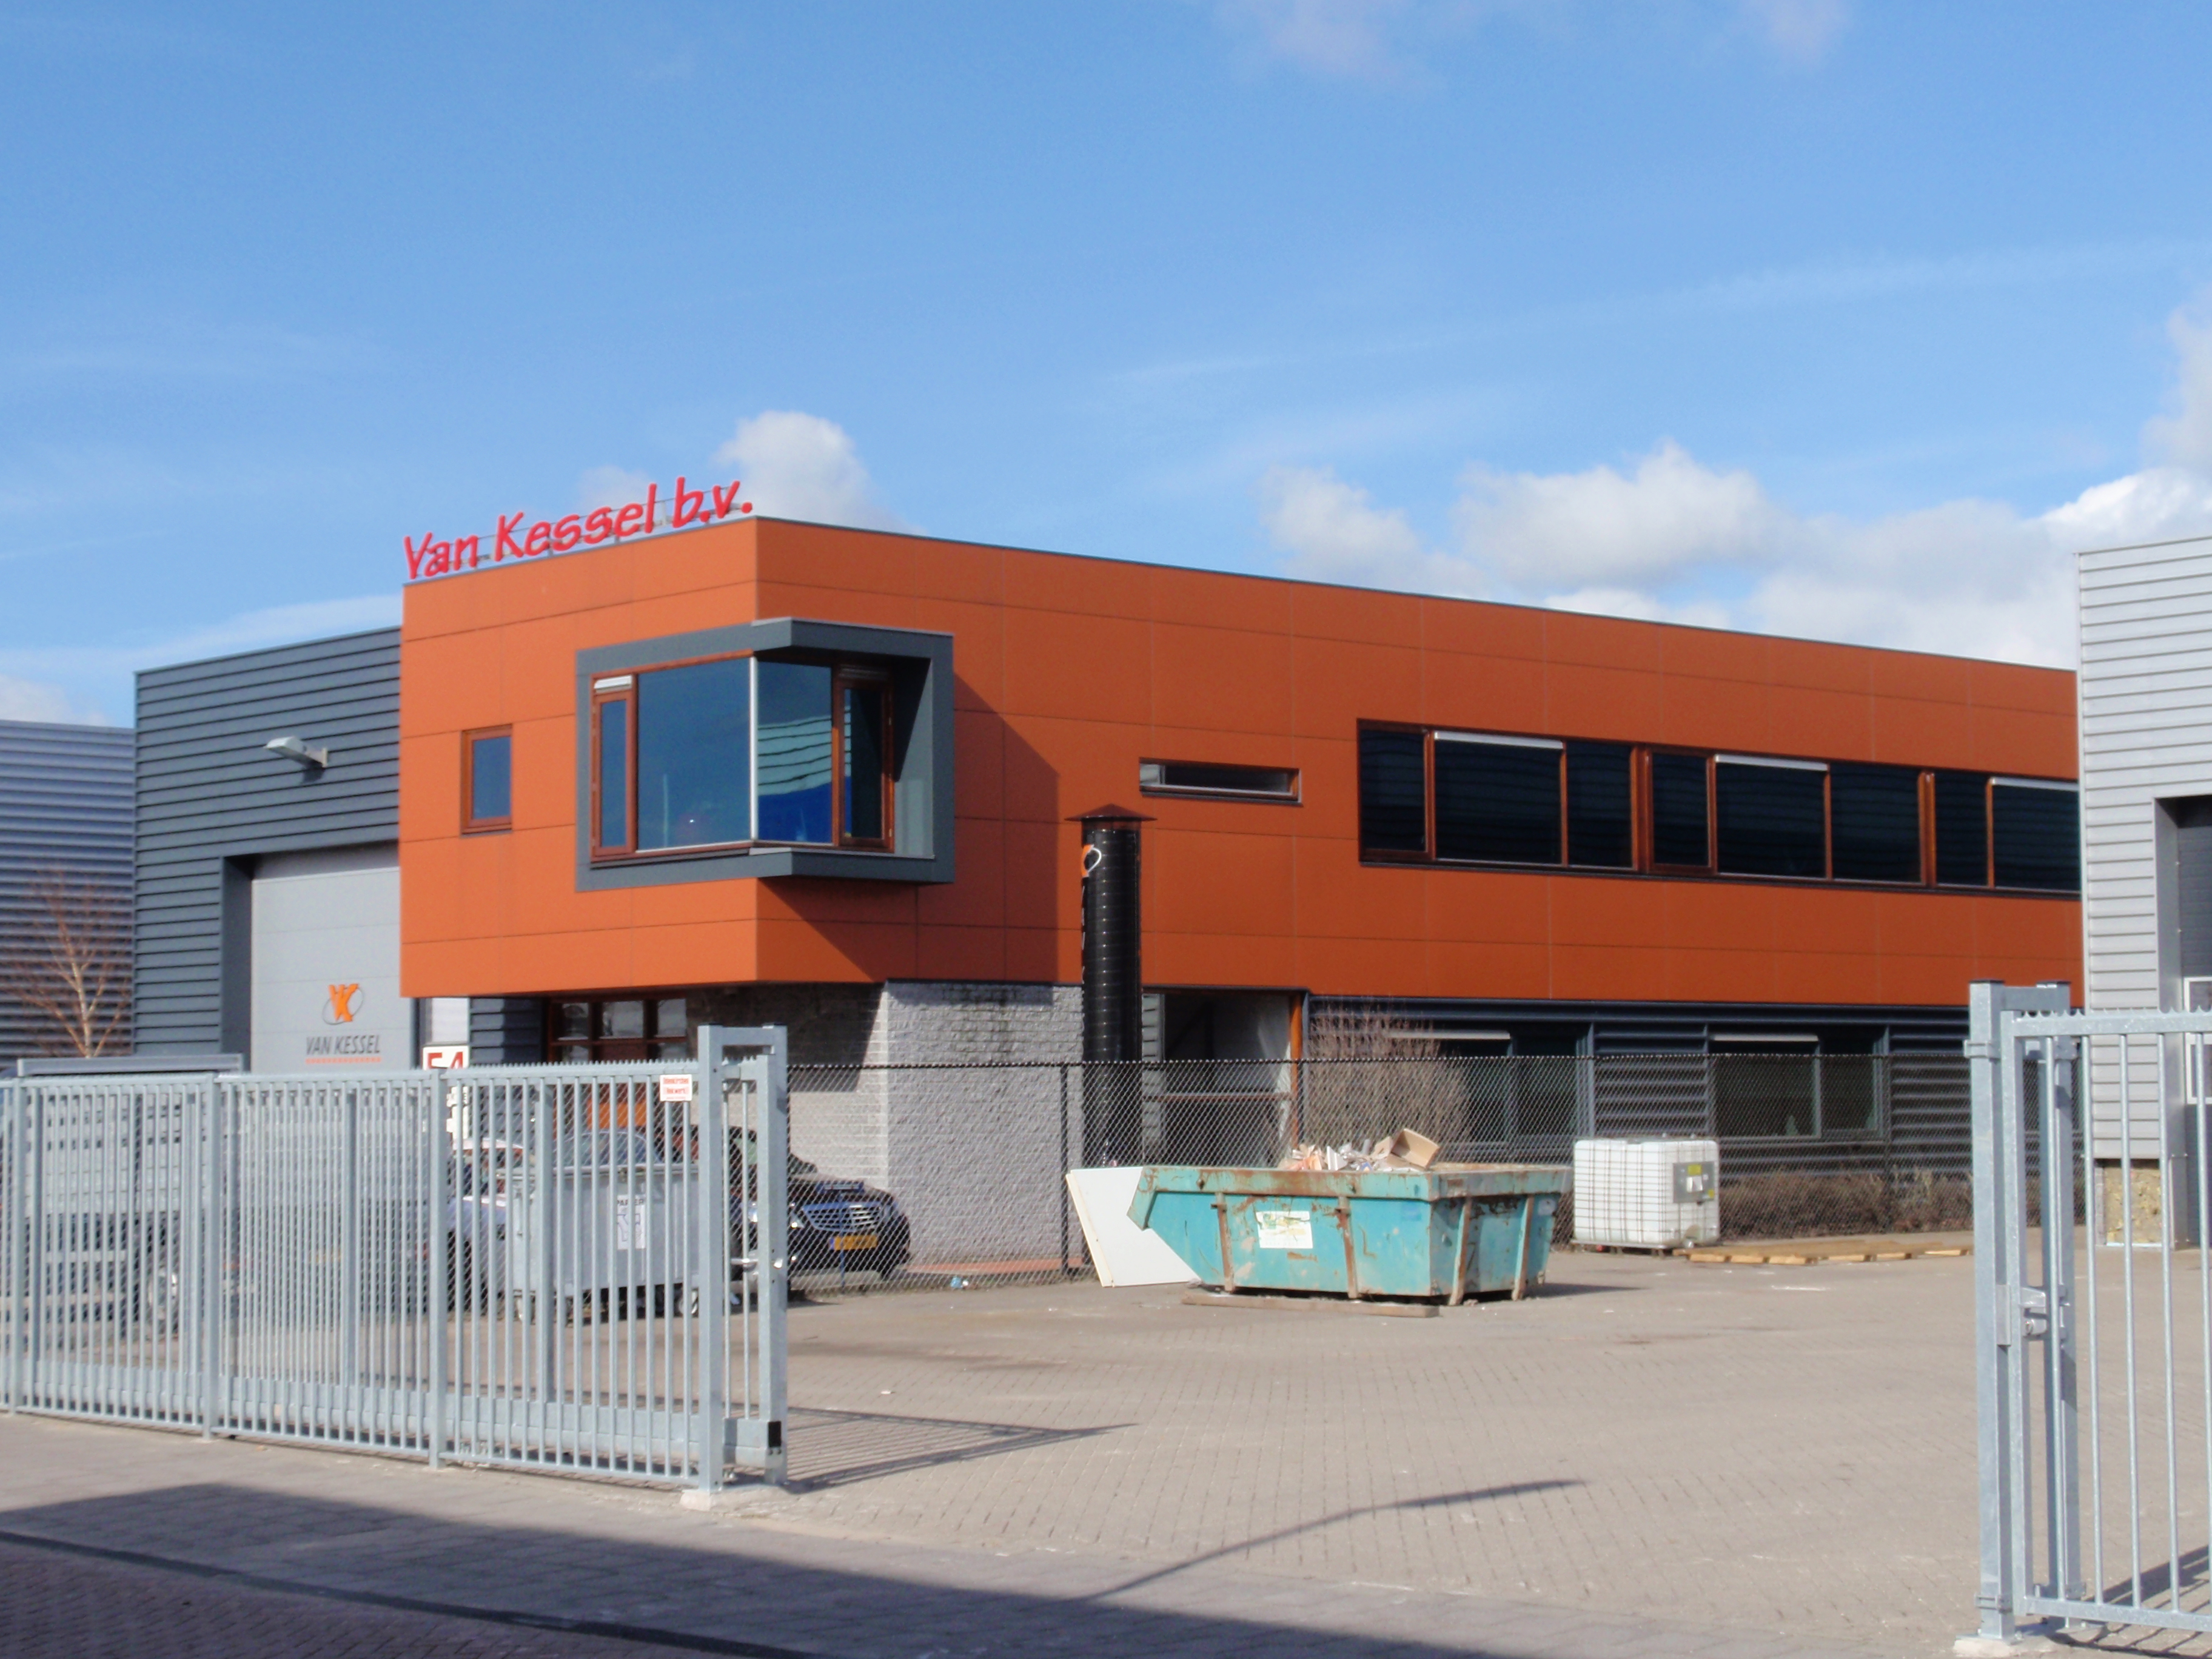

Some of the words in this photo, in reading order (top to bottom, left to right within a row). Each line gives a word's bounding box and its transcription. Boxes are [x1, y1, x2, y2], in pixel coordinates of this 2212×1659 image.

[403, 531, 478, 580] Van
[493, 483, 658, 562] Kessel
[672, 476, 753, 528] b.v.
[306, 1035, 332, 1056] VAN
[333, 1034, 381, 1054] KESSEL
